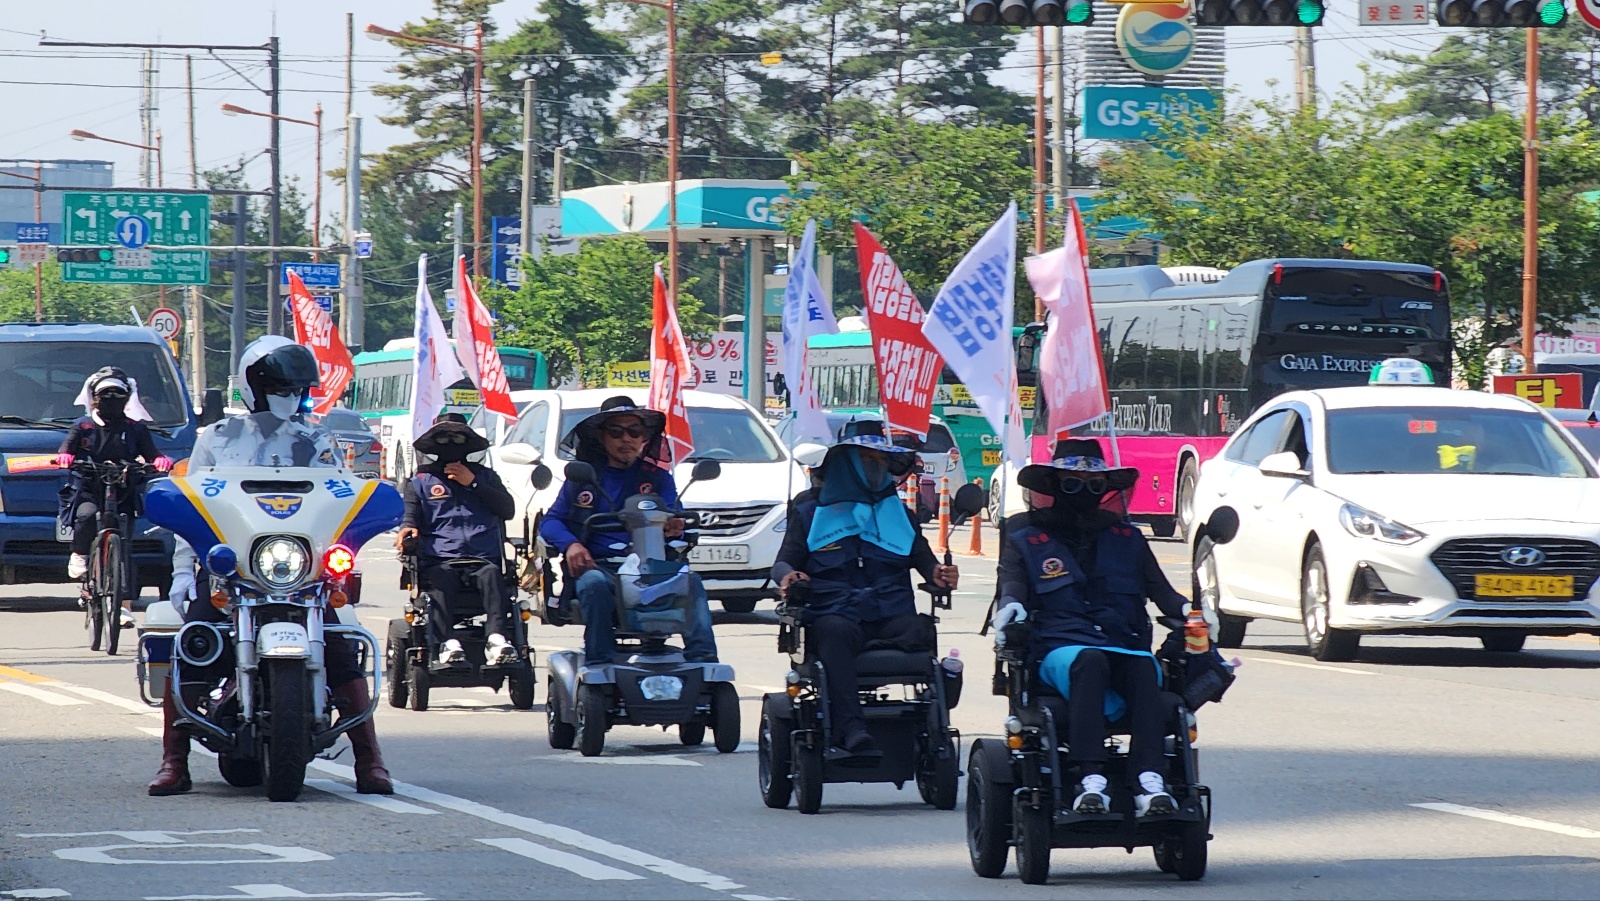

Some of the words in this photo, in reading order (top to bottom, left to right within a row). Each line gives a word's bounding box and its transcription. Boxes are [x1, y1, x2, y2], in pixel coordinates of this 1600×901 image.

[1097, 99, 1140, 127] GS
[745, 196, 787, 223] GS
[155, 318, 175, 332] 50
[1280, 354, 1318, 372] GAJA
[708, 547, 742, 560] 1146
